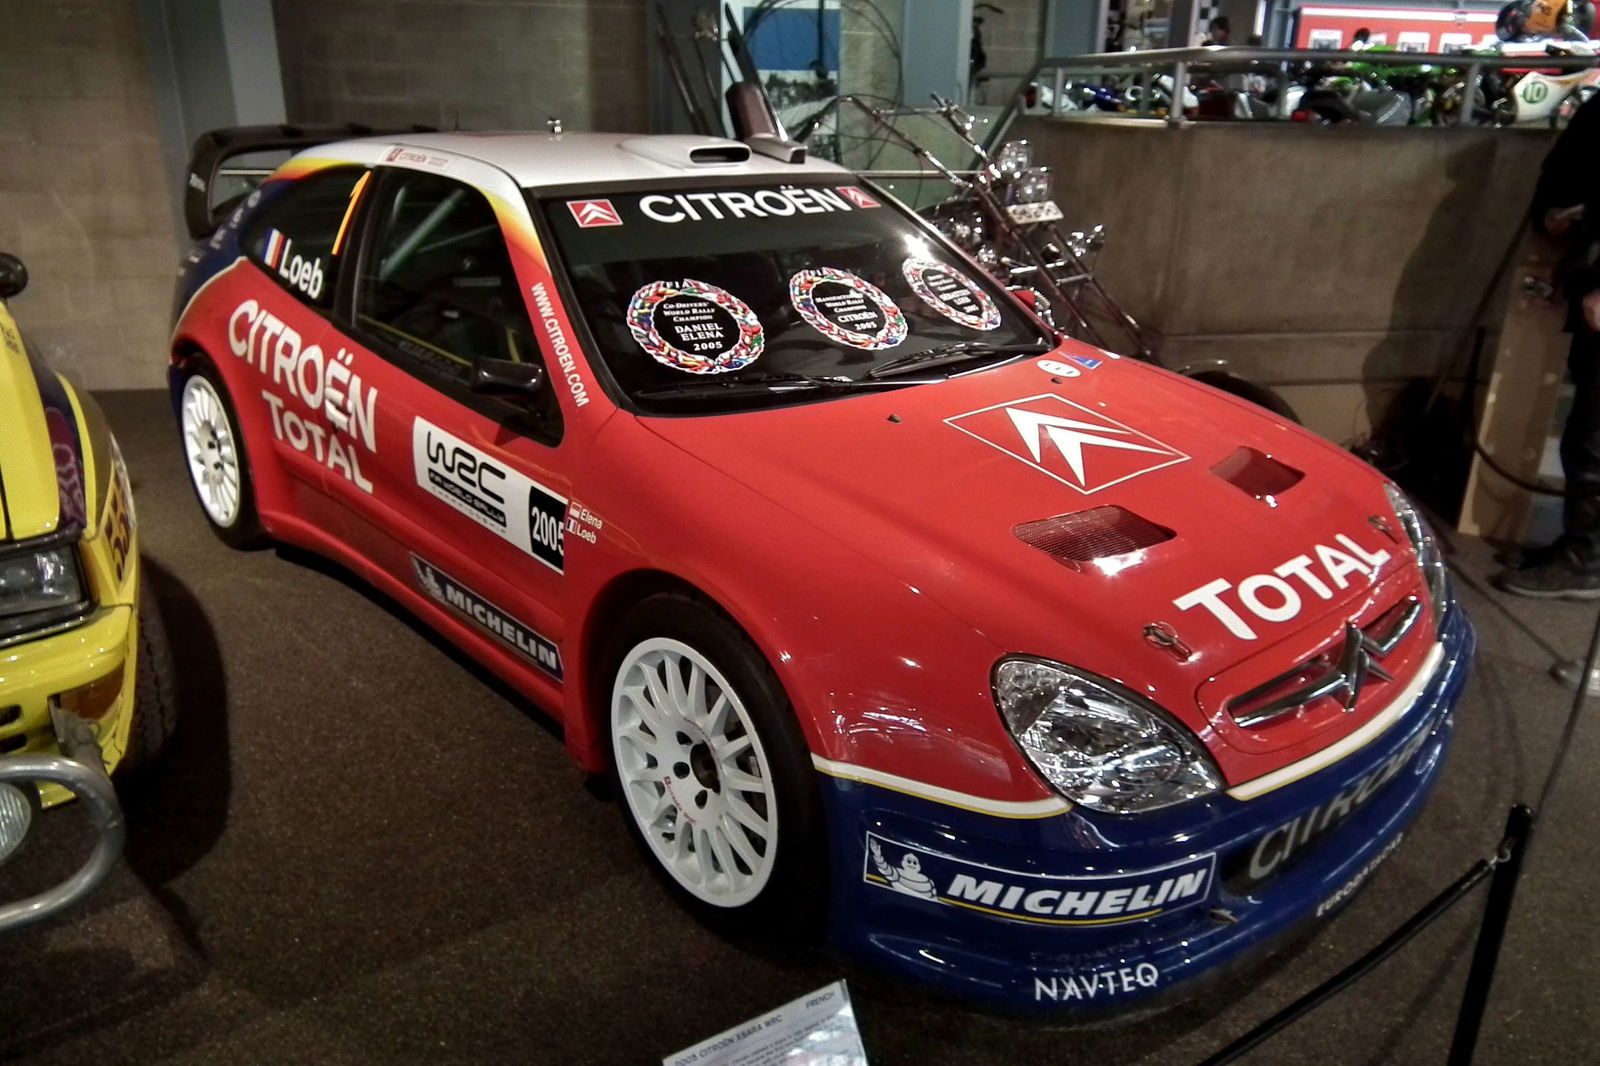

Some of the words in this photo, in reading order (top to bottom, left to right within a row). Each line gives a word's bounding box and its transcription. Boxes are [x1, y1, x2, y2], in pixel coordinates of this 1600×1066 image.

[639, 185, 852, 223] CITROËN
[278, 238, 323, 299] Loeb
[531, 282, 590, 407] WWW.CITROEN.COM
[674, 323, 723, 334] DANIEL
[681, 332, 724, 341] ELENA
[693, 342, 723, 351] 2005
[228, 299, 378, 454] CITROËN
[262, 390, 374, 495] TOTAL
[427, 431, 506, 504] WRC
[576, 524, 597, 544] Loeb
[580, 508, 603, 529] Elena
[1172, 533, 1392, 640] TOTAL
[446, 583, 557, 670] MICHELIN
[947, 868, 1207, 915] MICHELIN
[1034, 963, 1159, 1001] NAVTEQ
